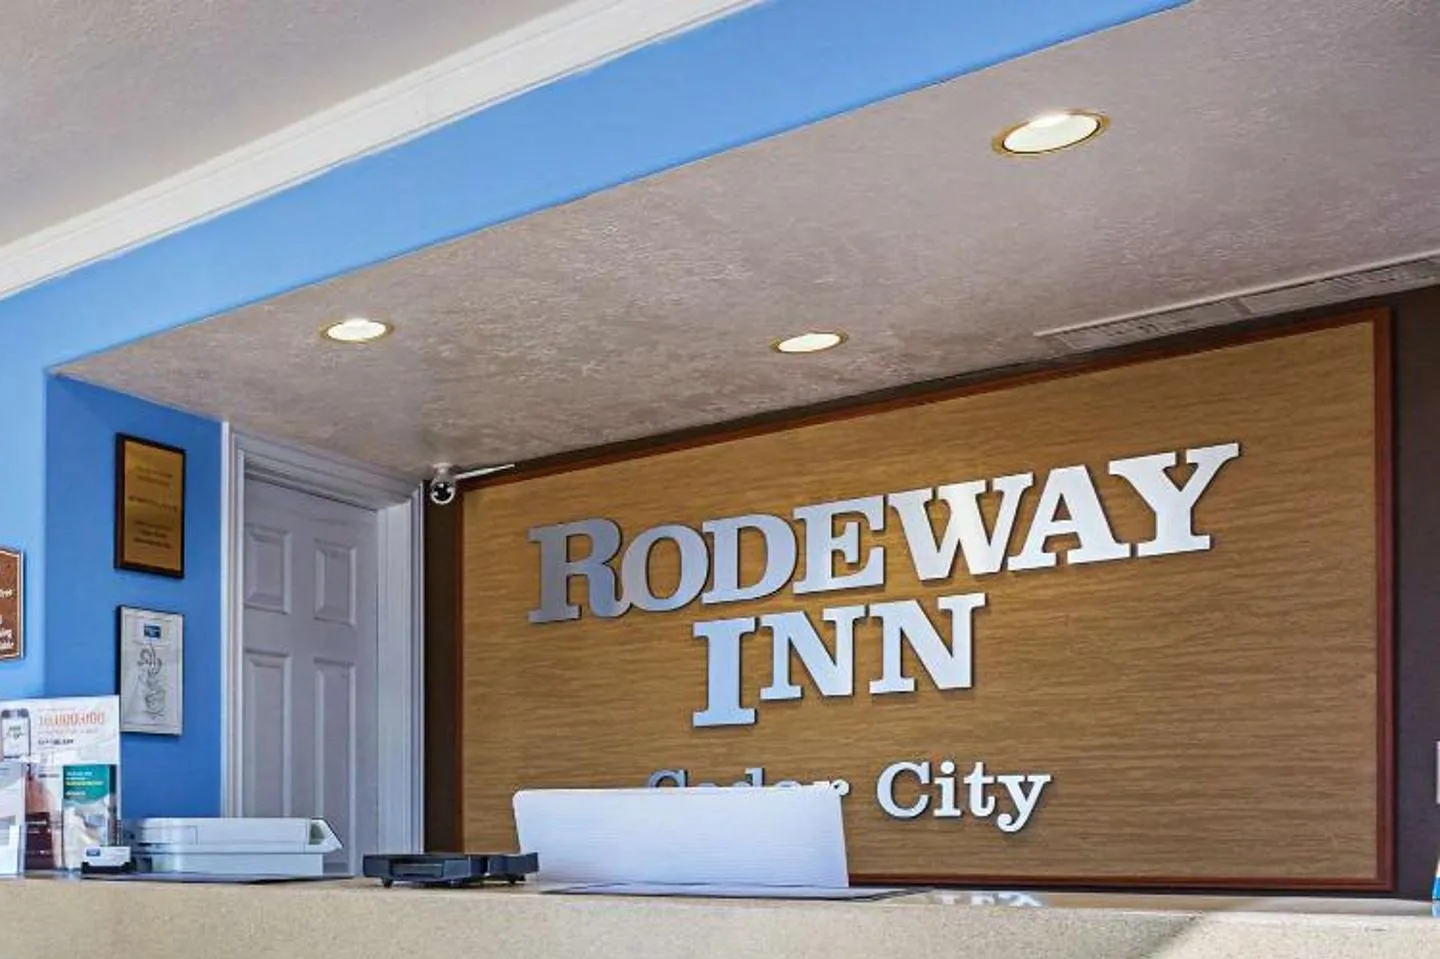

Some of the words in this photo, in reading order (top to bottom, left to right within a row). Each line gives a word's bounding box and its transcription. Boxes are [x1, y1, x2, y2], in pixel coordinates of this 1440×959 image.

[527, 443, 1241, 623] RODEWAY
[692, 592, 986, 727] INN
[876, 760, 1052, 833] City
